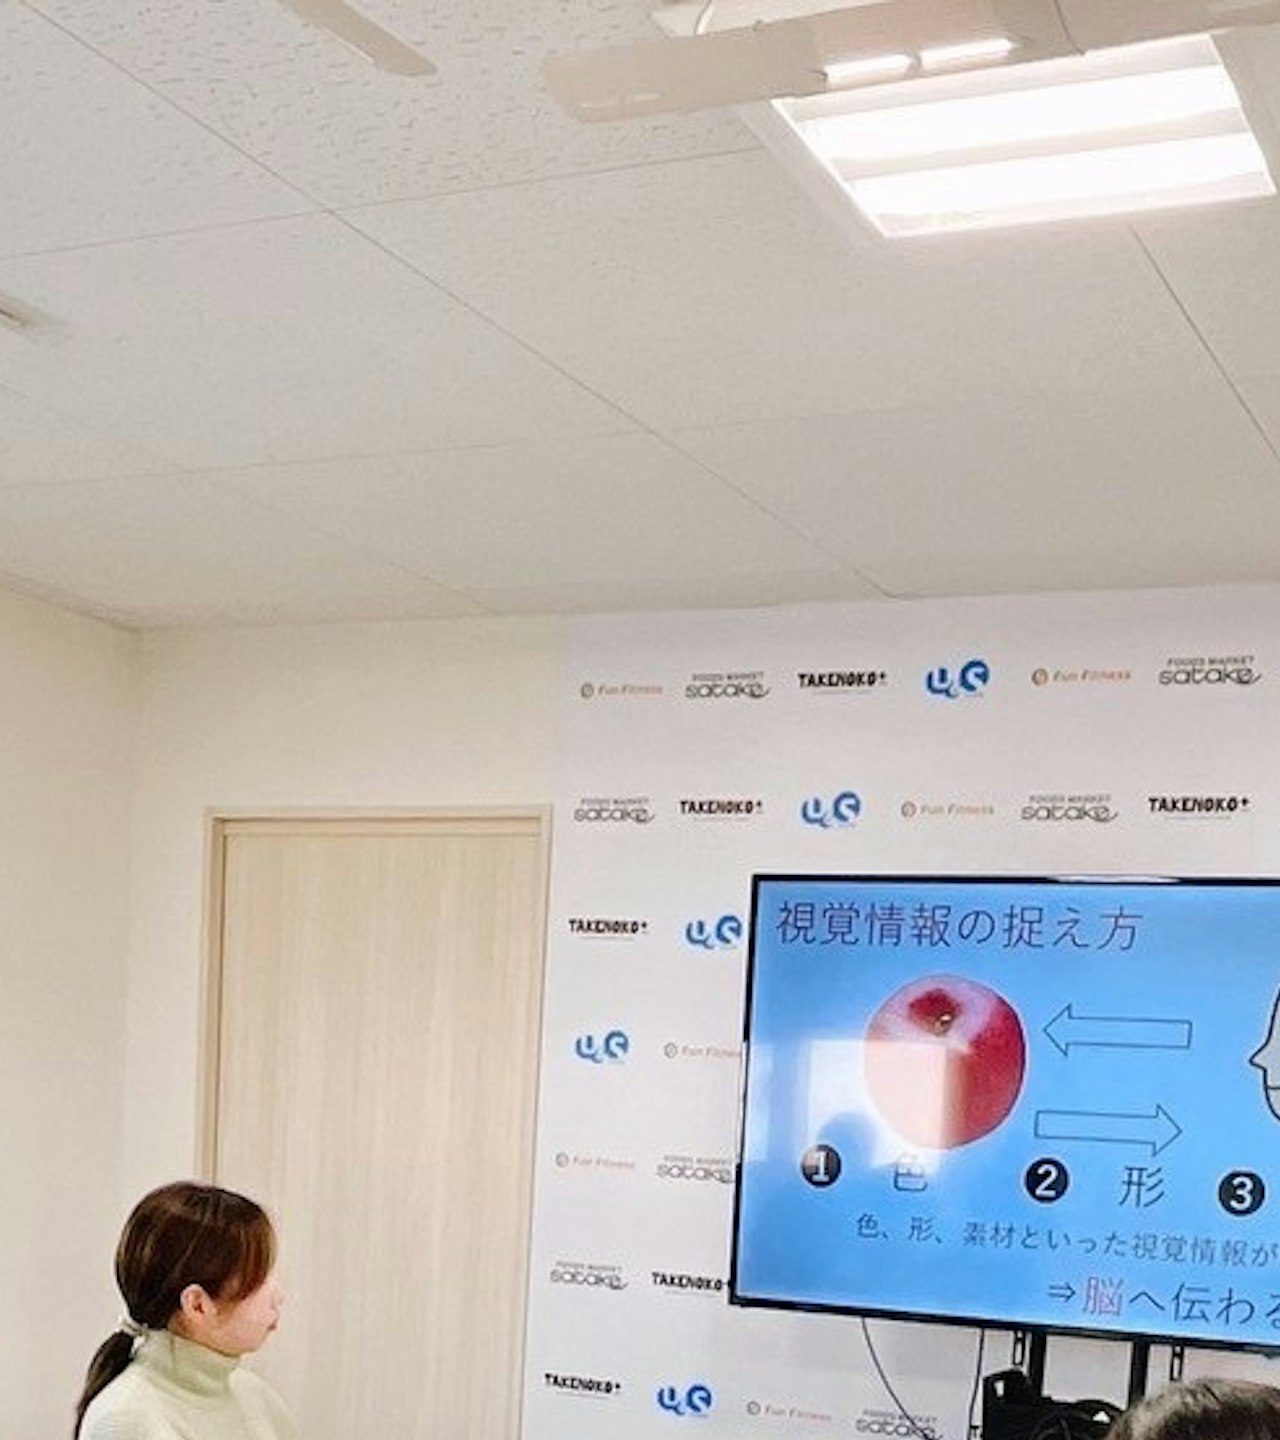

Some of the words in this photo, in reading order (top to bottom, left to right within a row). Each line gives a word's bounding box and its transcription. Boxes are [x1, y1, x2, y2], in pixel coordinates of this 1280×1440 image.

[1052, 670, 1080, 683] Fun
[1082, 669, 1131, 683] Fitness
[1159, 664, 1262, 687] satake
[685, 679, 770, 699] satake
[573, 804, 654, 823] satake
[921, 804, 946, 816] Fun
[949, 803, 995, 817] Fitness
[1021, 802, 1118, 823] satake
[776, 901, 1144, 950] 視覚情報の捉え方
[1120, 1166, 1165, 1208] 形
[551, 1268, 628, 1290] satake
